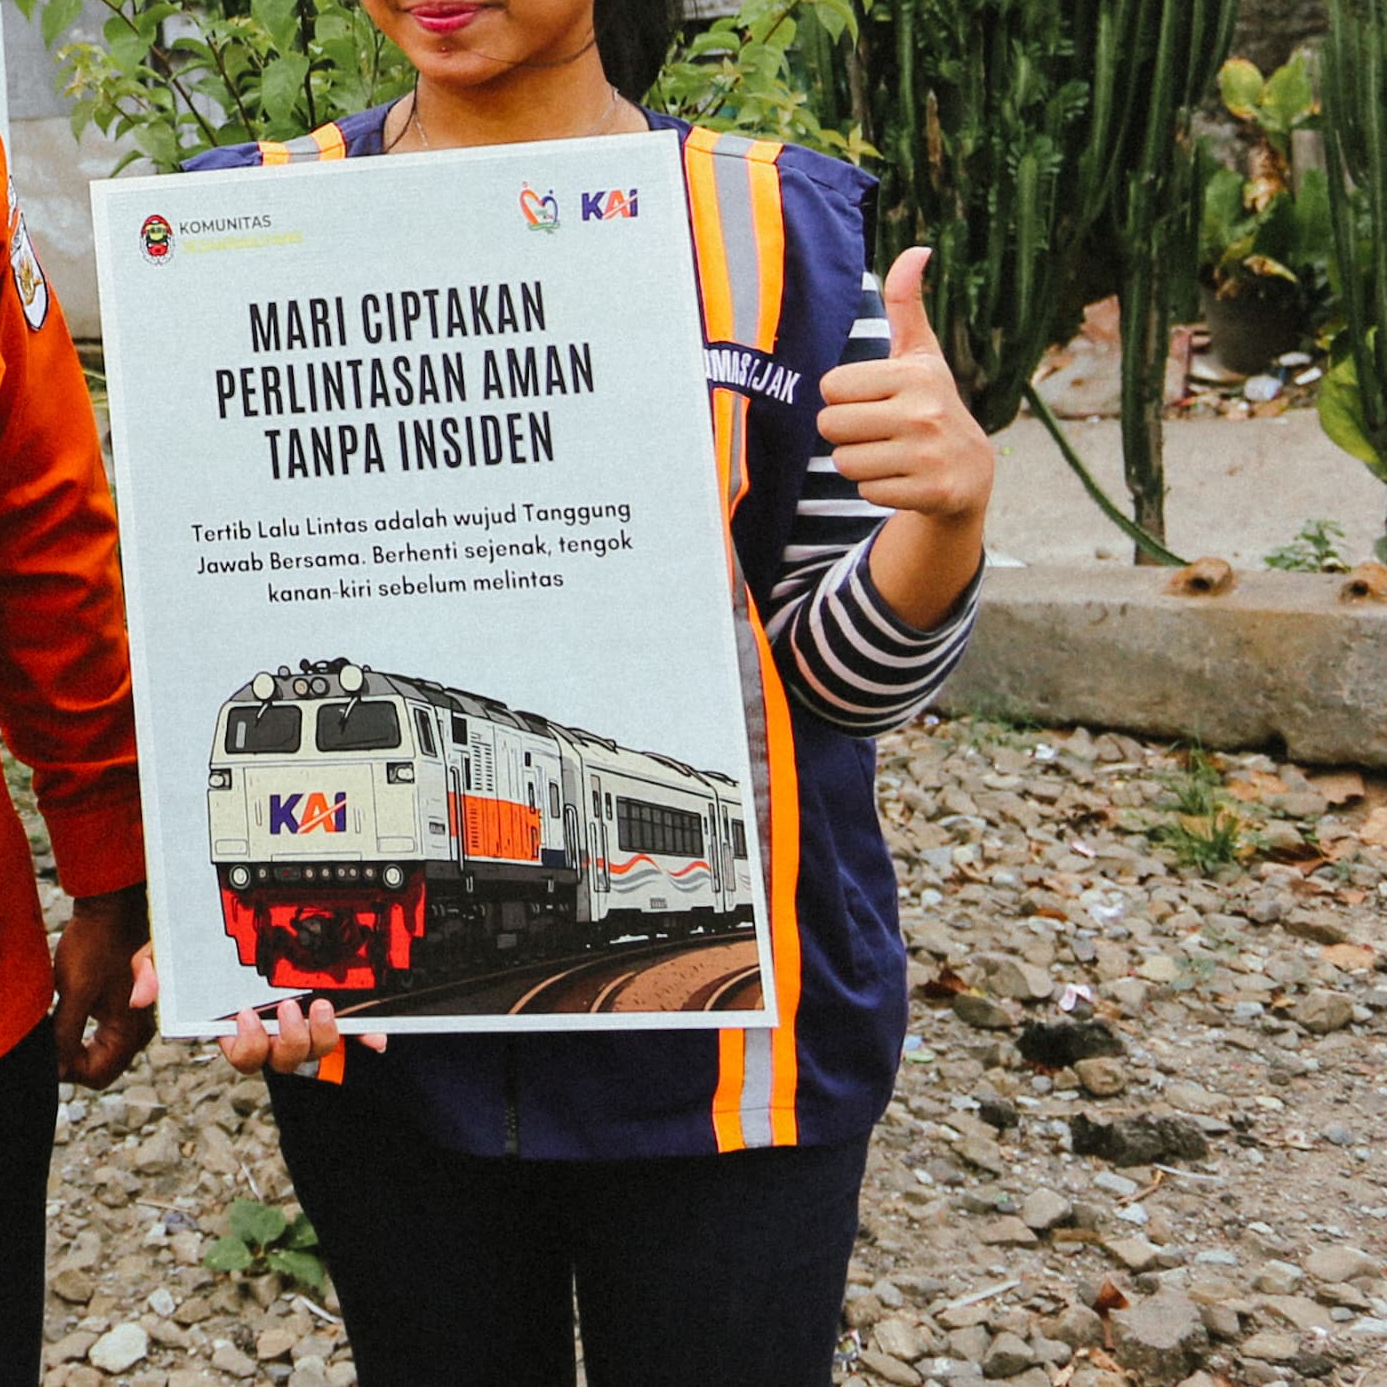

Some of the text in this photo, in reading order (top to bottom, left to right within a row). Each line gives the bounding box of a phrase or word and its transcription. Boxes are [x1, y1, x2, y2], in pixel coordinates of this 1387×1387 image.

[180, 215, 272, 235] KOMUNITAS
[248, 280, 547, 354] MARI CIPTAKAN
[215, 341, 595, 420] PERLINTASAN AMAN
[263, 410, 555, 481] TANPA INSIDEN
[190, 502, 631, 543] Tertib Lalu Lintas adalah wujud Tanggung
[196, 528, 634, 575] Jawab Bersama. Berhenti sejenak, tengok
[267, 568, 564, 603] kanan-kiri sebelum melintas
